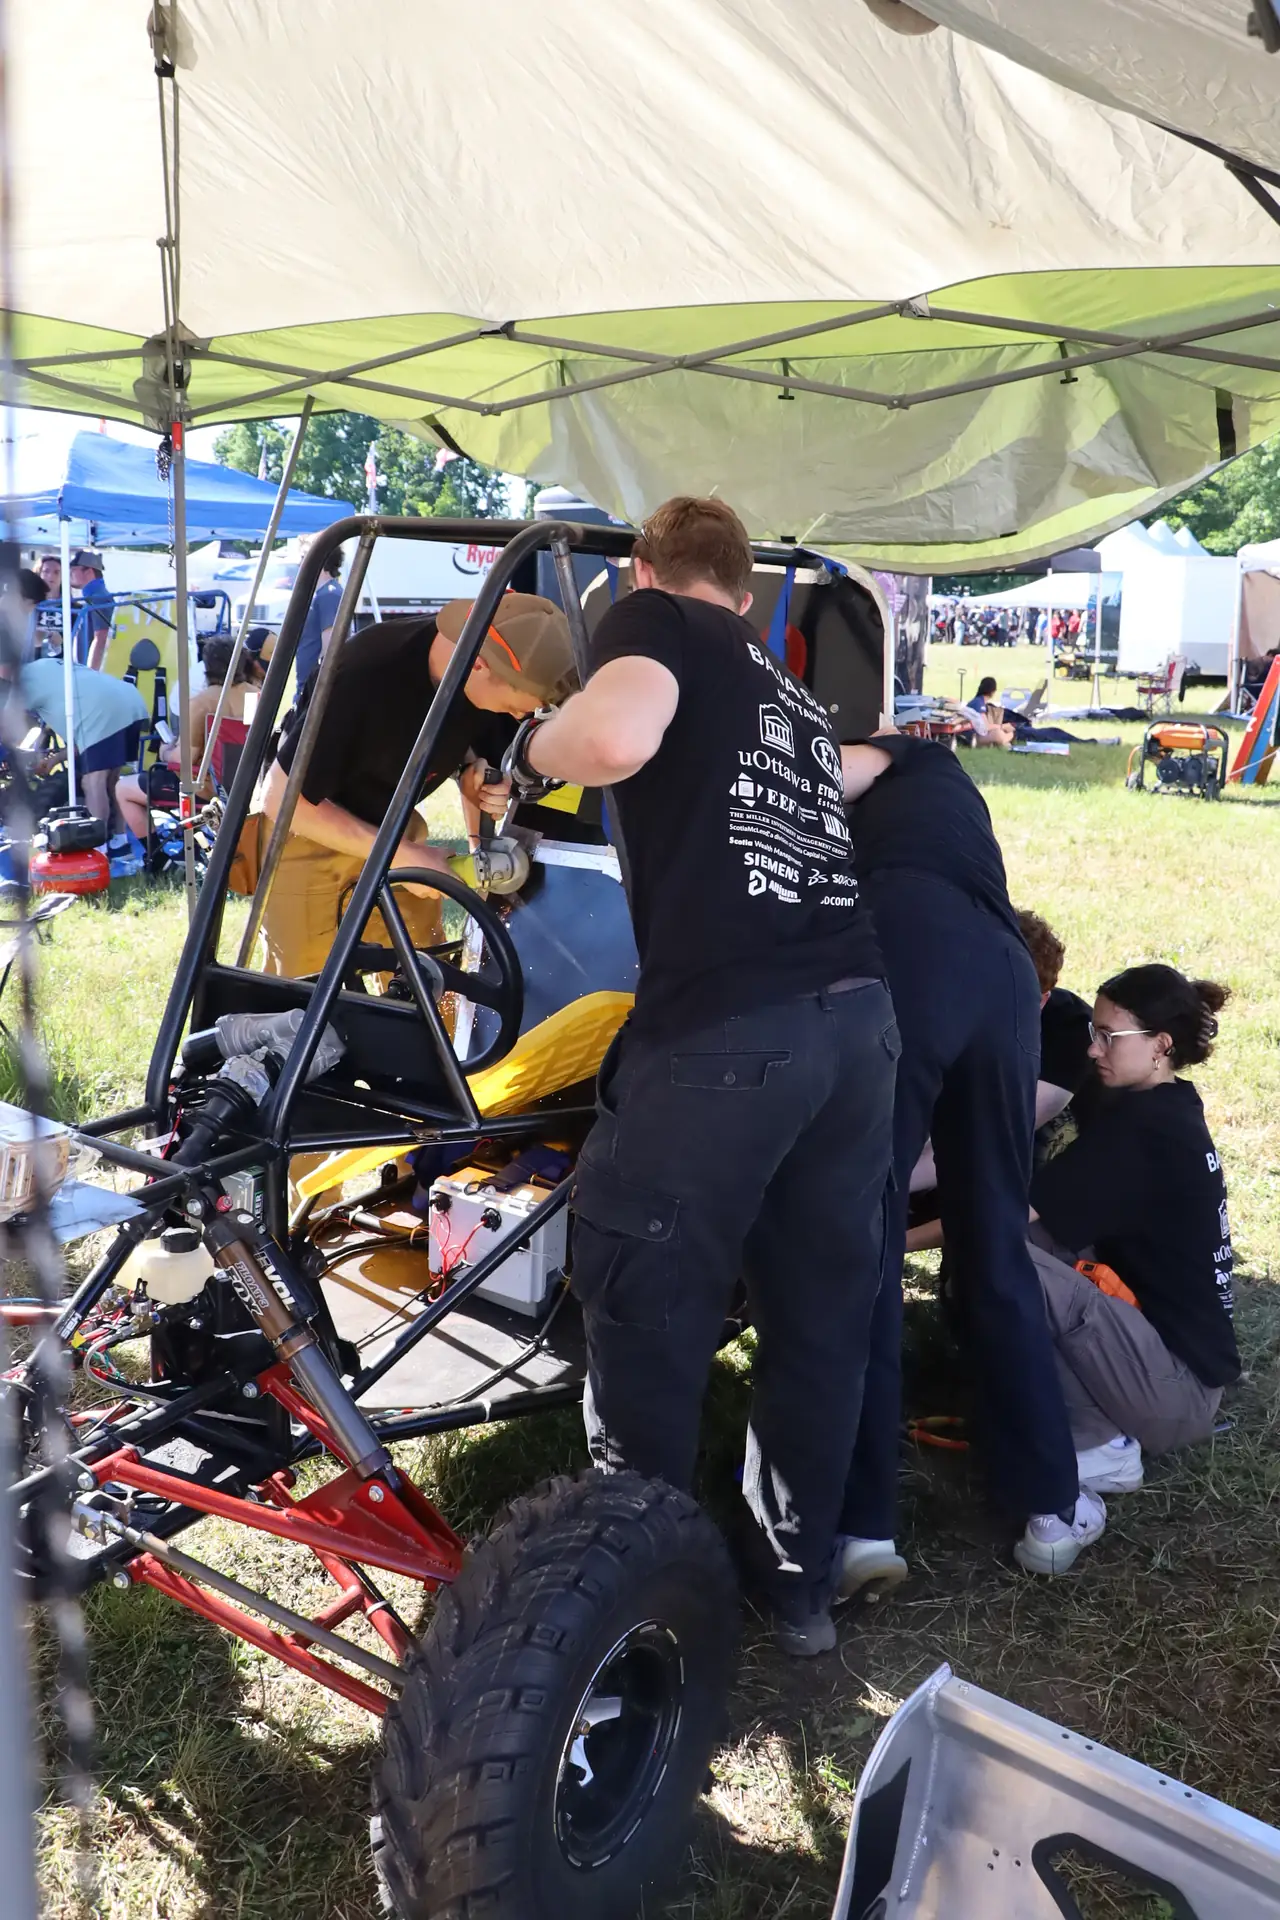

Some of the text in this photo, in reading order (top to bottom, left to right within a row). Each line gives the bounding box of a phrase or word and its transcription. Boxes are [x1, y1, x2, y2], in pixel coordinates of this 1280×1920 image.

[738, 750, 812, 793] uOttawa
[767, 788, 797, 815] EEF
[818, 783, 839, 802] ETBO
[729, 836, 753, 847] Scotia
[754, 840, 773, 853] Wealth
[730, 811, 744, 819] THE
[746, 813, 770, 824] MILLER
[797, 834, 831, 851] MANAGEMENT
[832, 847, 848, 857] GROUP
[744, 852, 800, 884] SIEMENS
[769, 880, 798, 899] Altium
[225, 1265, 264, 1316] FOX
